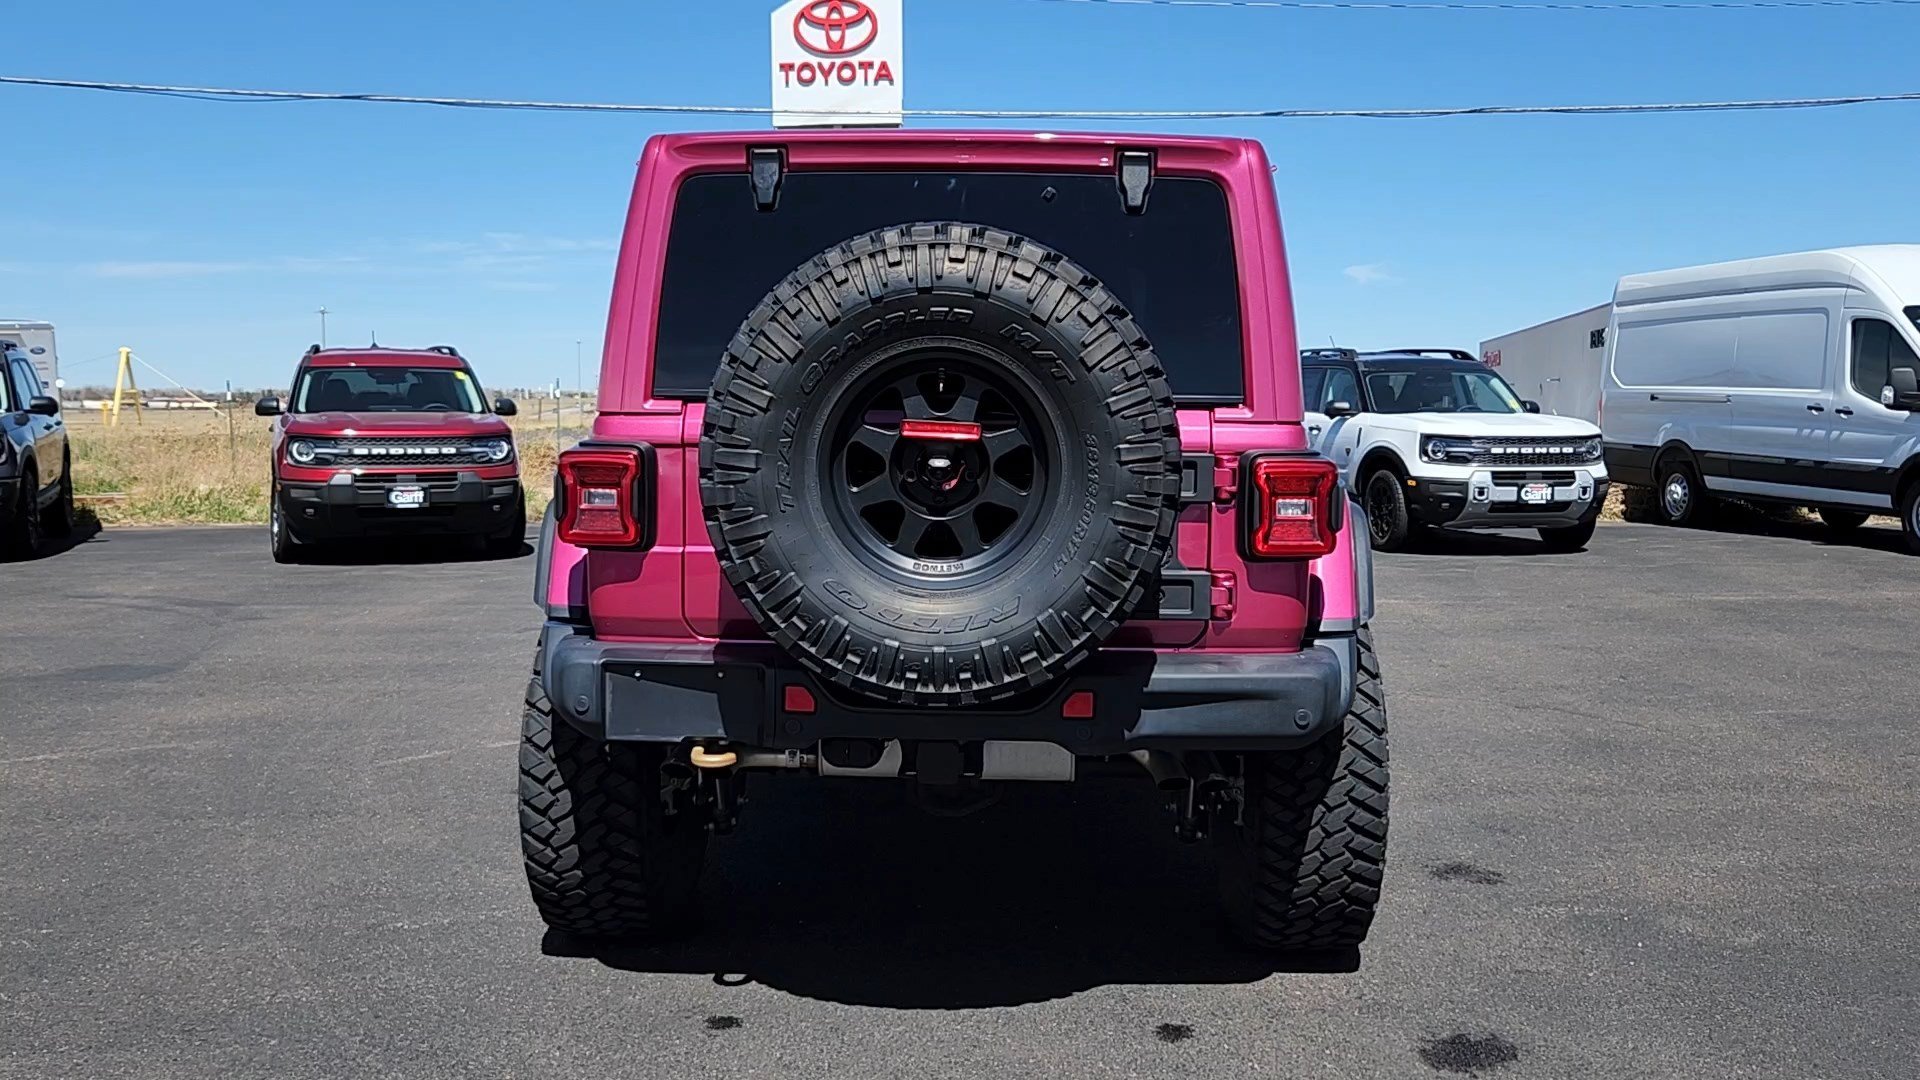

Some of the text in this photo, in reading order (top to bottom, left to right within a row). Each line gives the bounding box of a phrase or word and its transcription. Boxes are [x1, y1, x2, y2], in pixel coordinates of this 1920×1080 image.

[779, 61, 894, 87] TOYOTA
[775, 307, 1076, 513] TRAIL GRAPPLER M/T
[353, 447, 457, 455] BRONCO
[388, 490, 425, 503] Garff
[1520, 487, 1553, 500] Garff
[912, 562, 964, 573] METHOD
[822, 578, 1021, 634] NITTO
